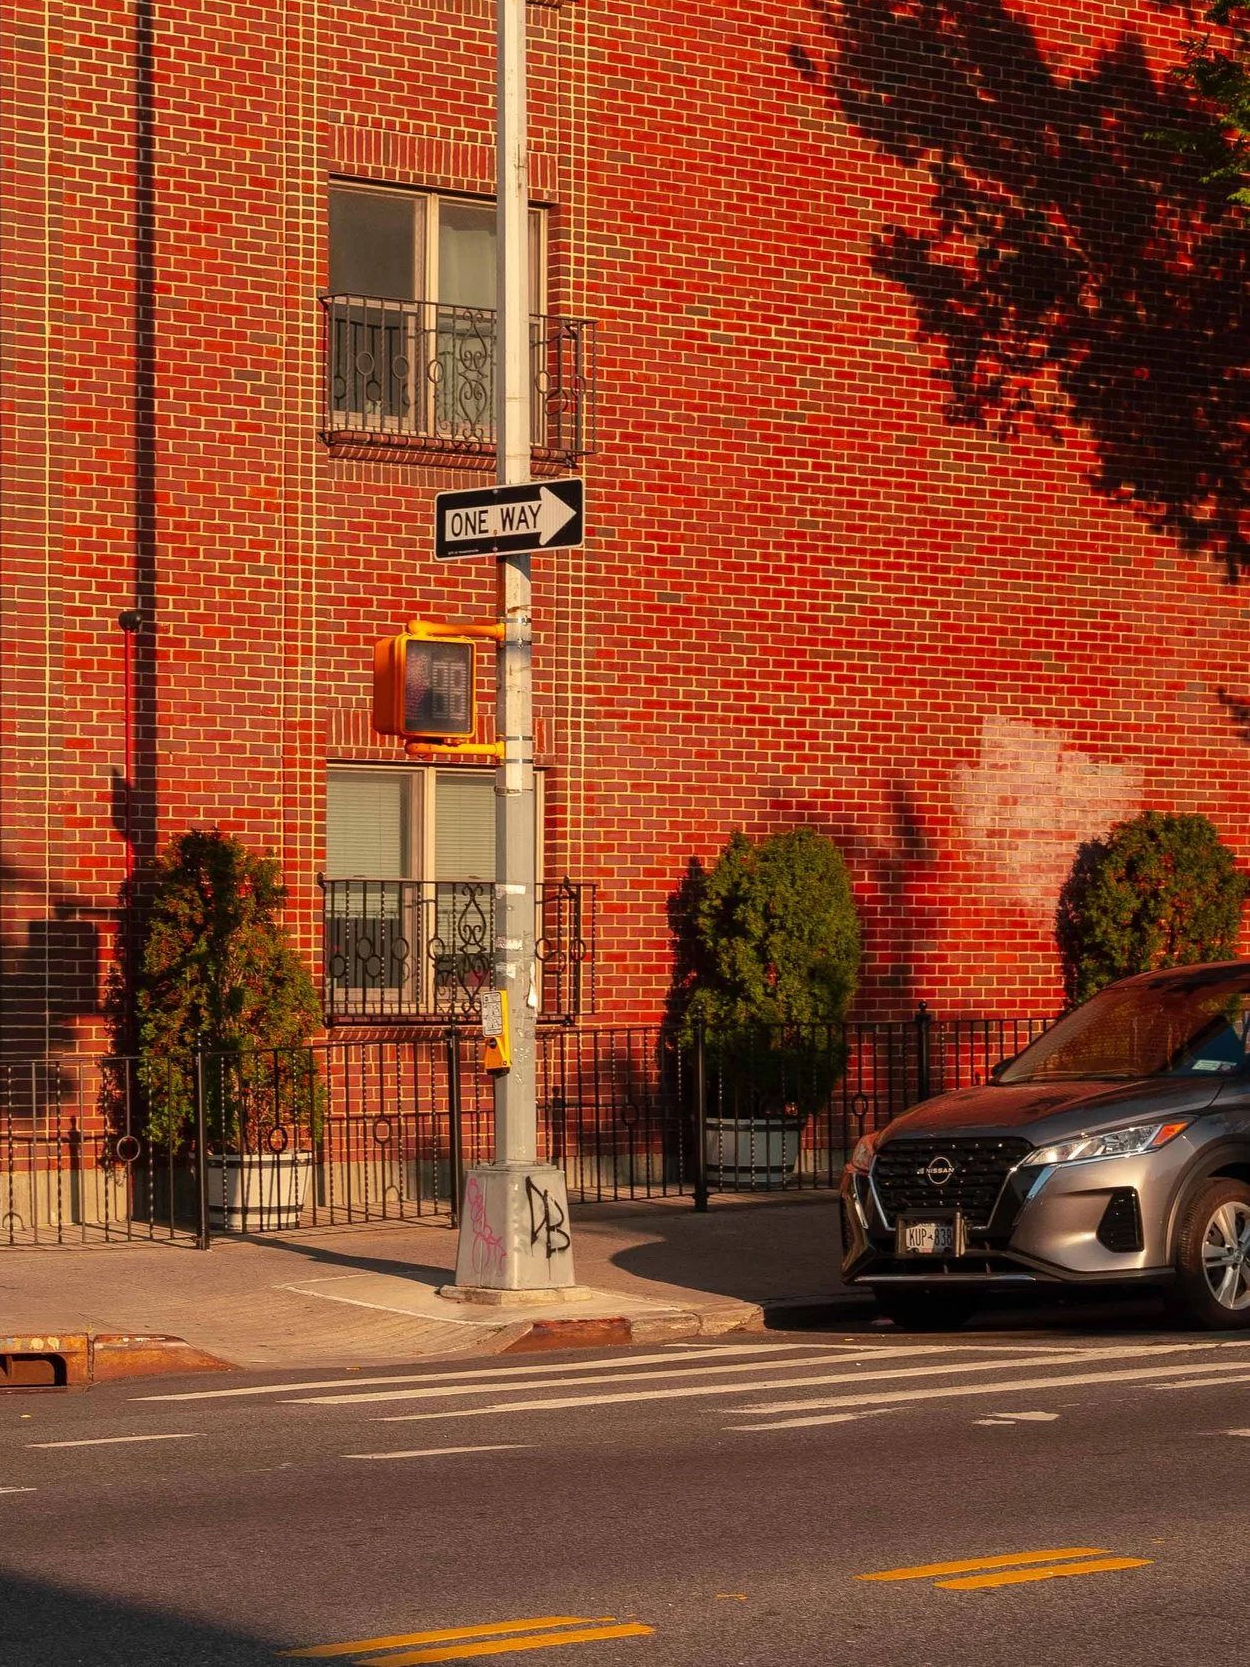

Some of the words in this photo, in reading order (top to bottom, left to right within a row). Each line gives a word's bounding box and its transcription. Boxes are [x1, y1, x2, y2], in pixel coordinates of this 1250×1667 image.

[451, 510, 489, 537] ONE
[500, 504, 542, 532] WAY
[909, 1228, 927, 1246] KUP
